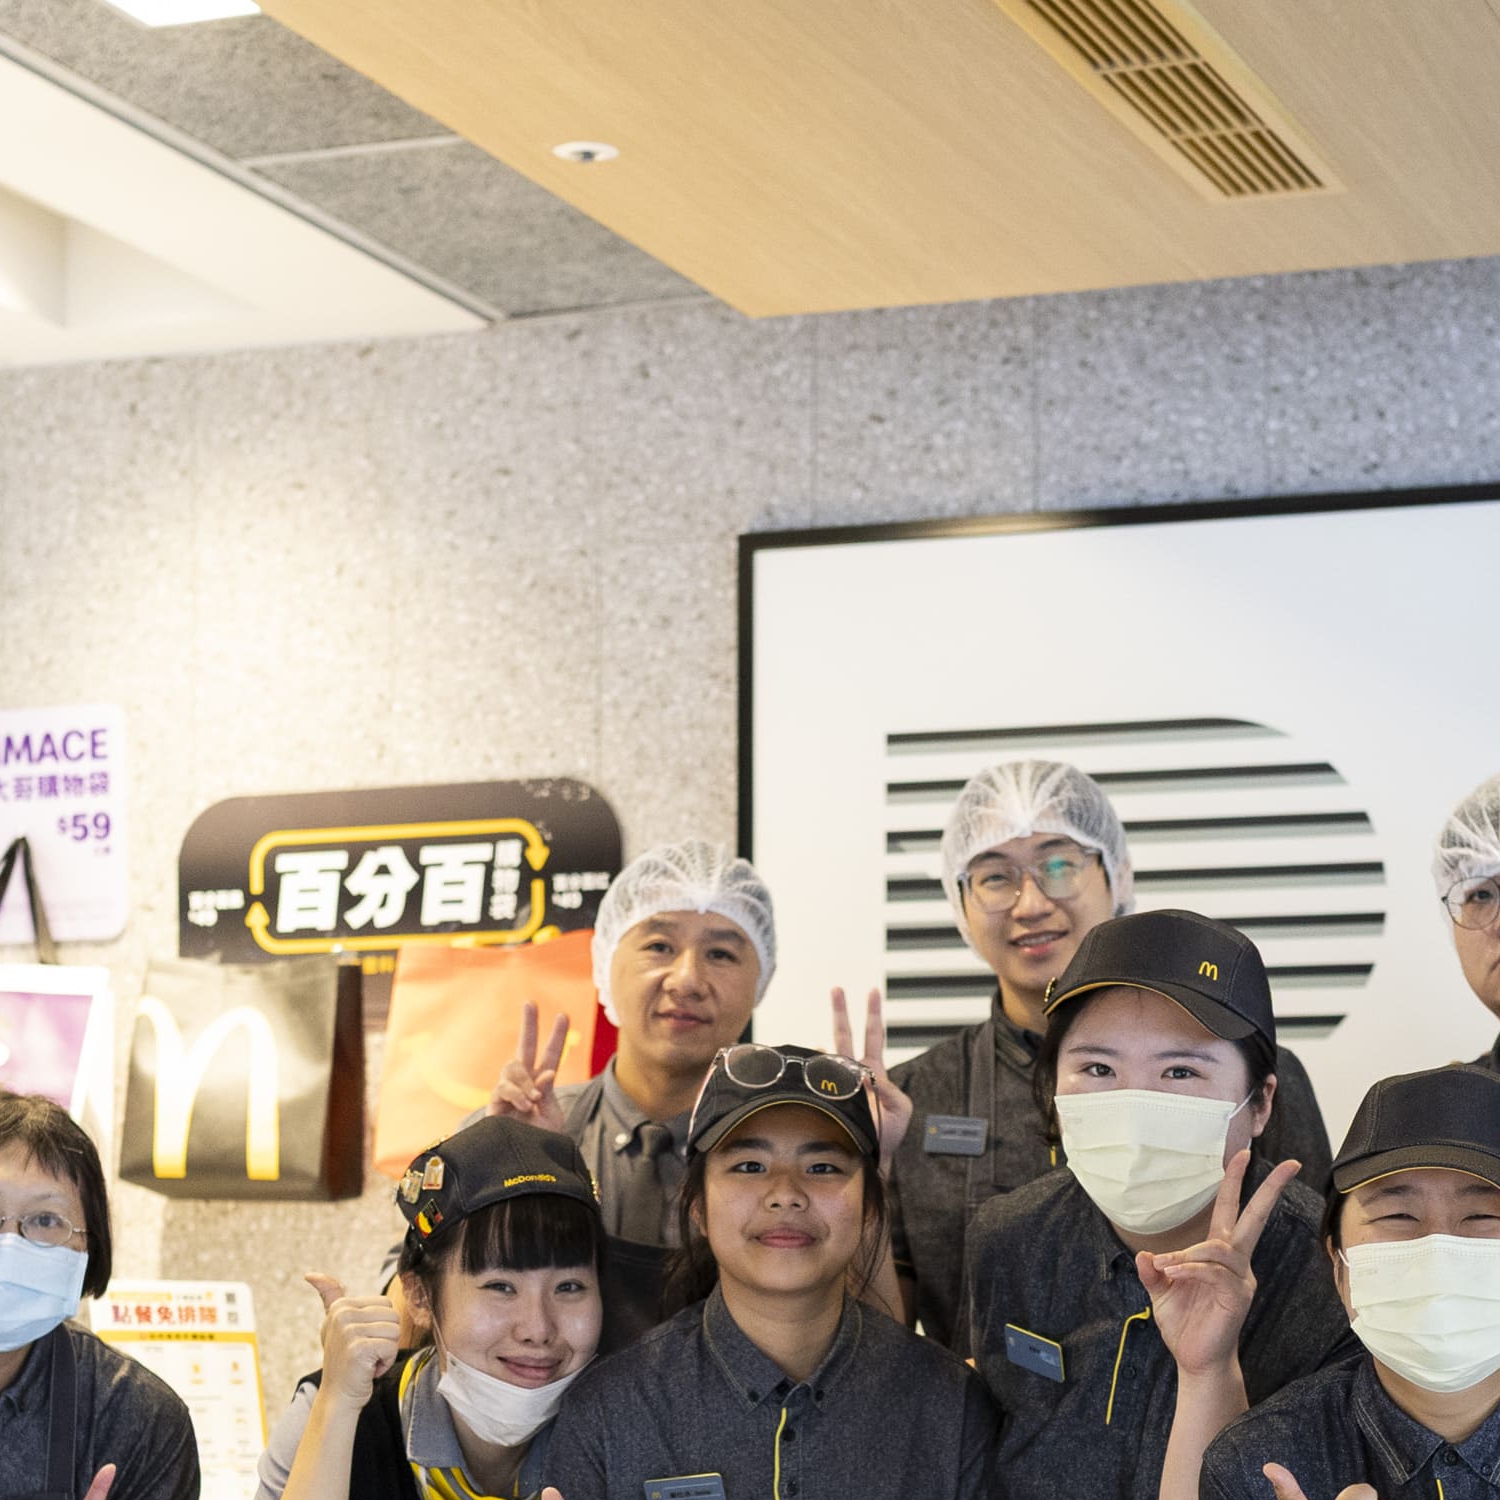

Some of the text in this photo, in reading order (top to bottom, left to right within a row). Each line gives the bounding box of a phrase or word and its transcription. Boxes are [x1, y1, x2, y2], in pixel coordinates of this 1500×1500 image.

[57, 811, 111, 841] $59
[275, 842, 493, 933] 百分百
